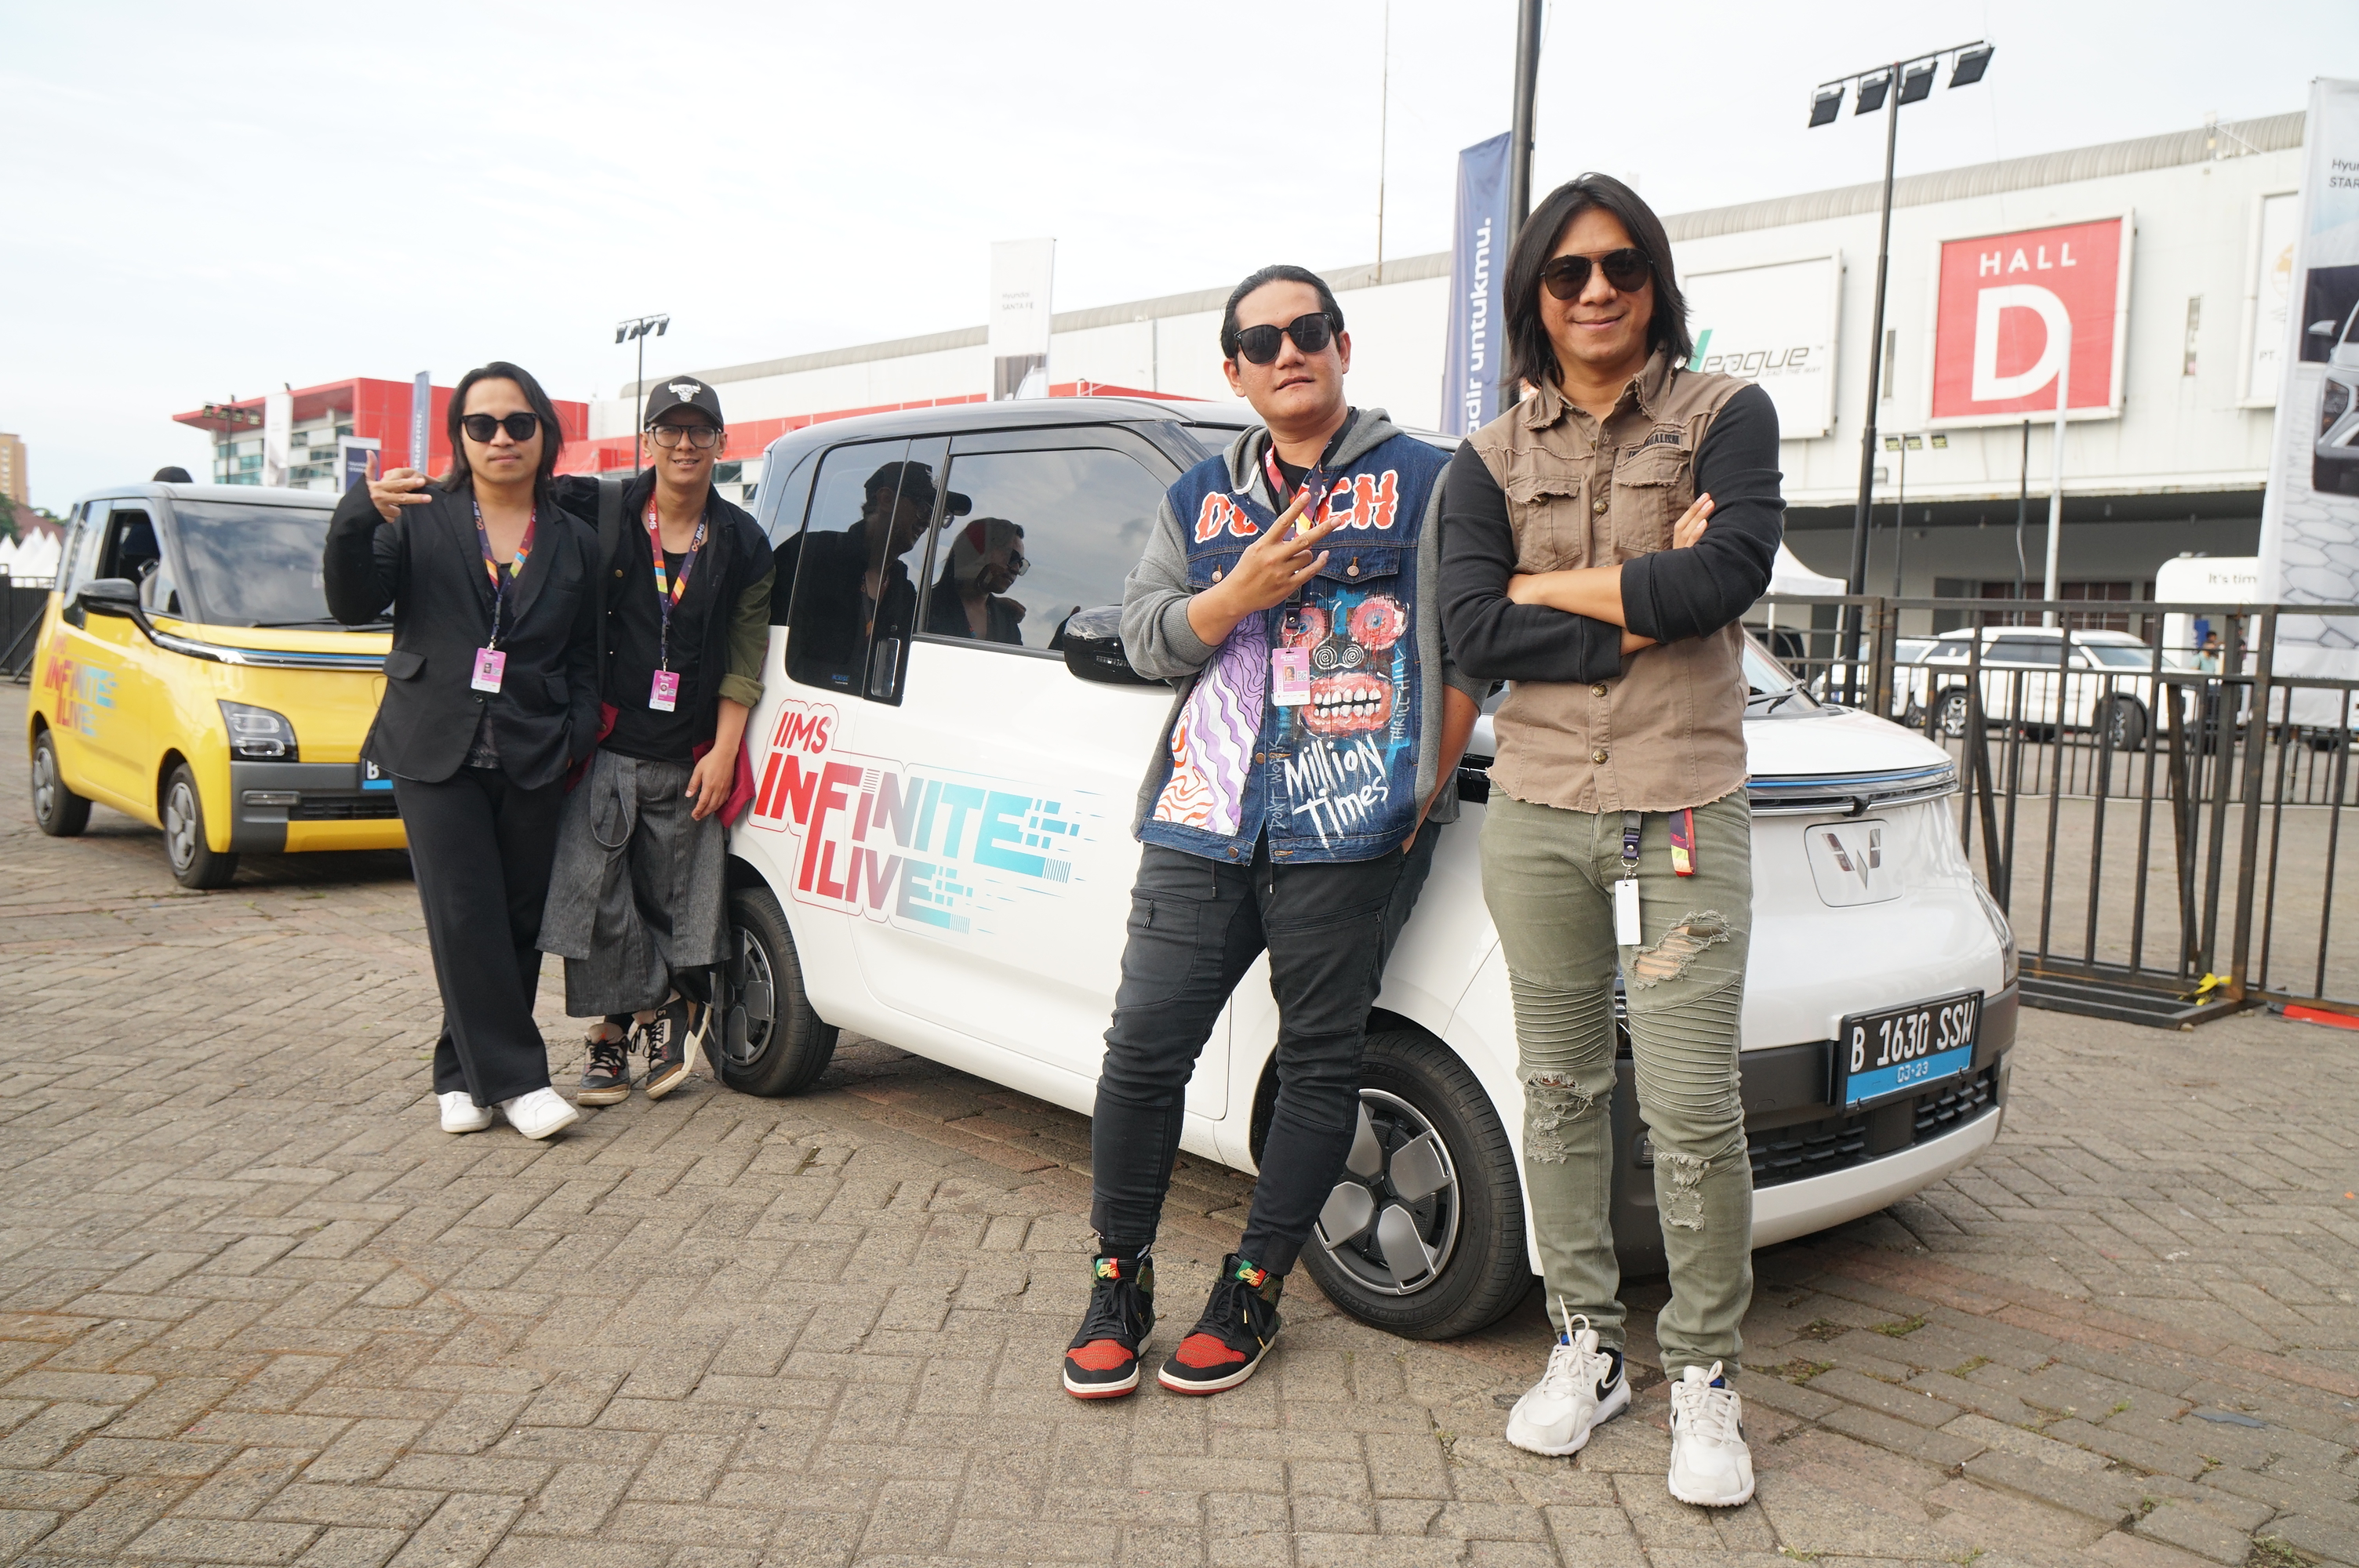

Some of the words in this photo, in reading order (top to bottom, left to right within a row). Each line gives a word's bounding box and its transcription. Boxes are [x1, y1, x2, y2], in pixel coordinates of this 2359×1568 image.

[1468, 216, 1491, 372] untukmu.
[1979, 241, 2077, 278] HALL
[1971, 283, 2072, 402] D
[1465, 377, 1482, 436] adir
[2208, 573, 2229, 584] It's
[2232, 573, 2258, 585] tim
[773, 710, 833, 754] IIMS
[754, 751, 1081, 892] INFINITE
[816, 839, 975, 935] LIVE
[1849, 1025, 1866, 1073] B
[1876, 1011, 1931, 1067] 1630
[1936, 1000, 1976, 1051] SSW
